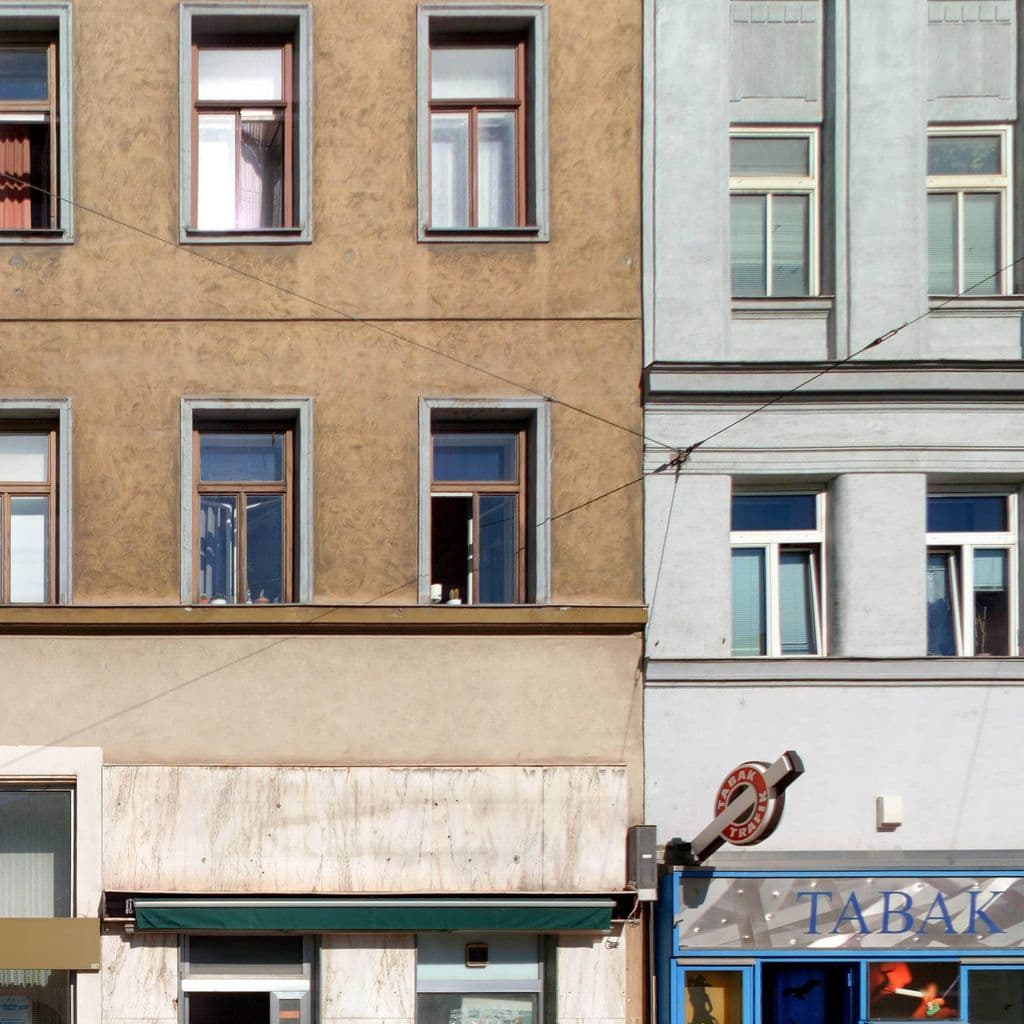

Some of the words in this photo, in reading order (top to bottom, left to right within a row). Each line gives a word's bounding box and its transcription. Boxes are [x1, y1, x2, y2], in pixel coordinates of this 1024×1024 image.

[718, 769, 756, 808] TABAK
[729, 791, 767, 838] TRAFIK
[796, 890, 1007, 935] TABAK
